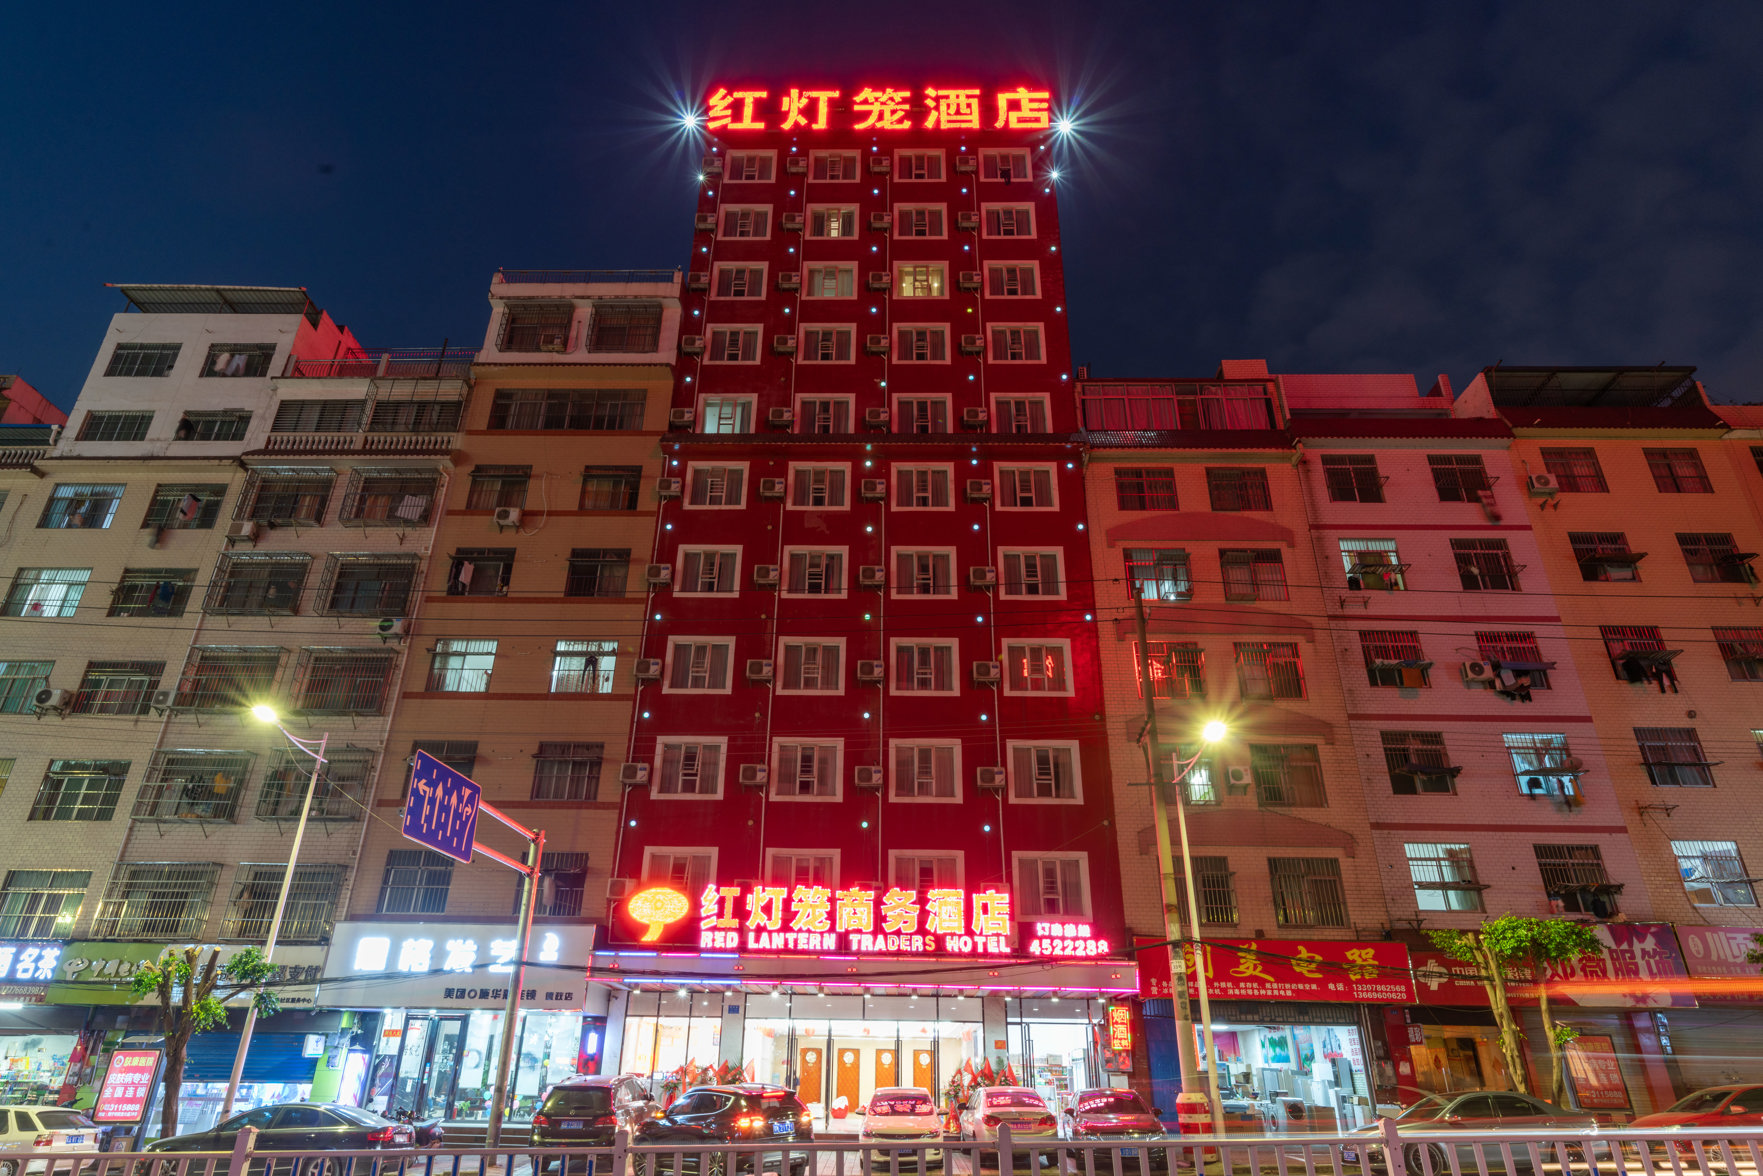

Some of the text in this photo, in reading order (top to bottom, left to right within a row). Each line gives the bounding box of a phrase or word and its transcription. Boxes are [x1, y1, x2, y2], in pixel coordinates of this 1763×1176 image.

[707, 87, 1051, 131] 红灯笼酒店
[701, 884, 1012, 936] 红灯笼商务酒店
[700, 931, 1012, 954] RED LANTERN TRADERS HOTEL
[1112, 1009, 1128, 1039] 烟酒
